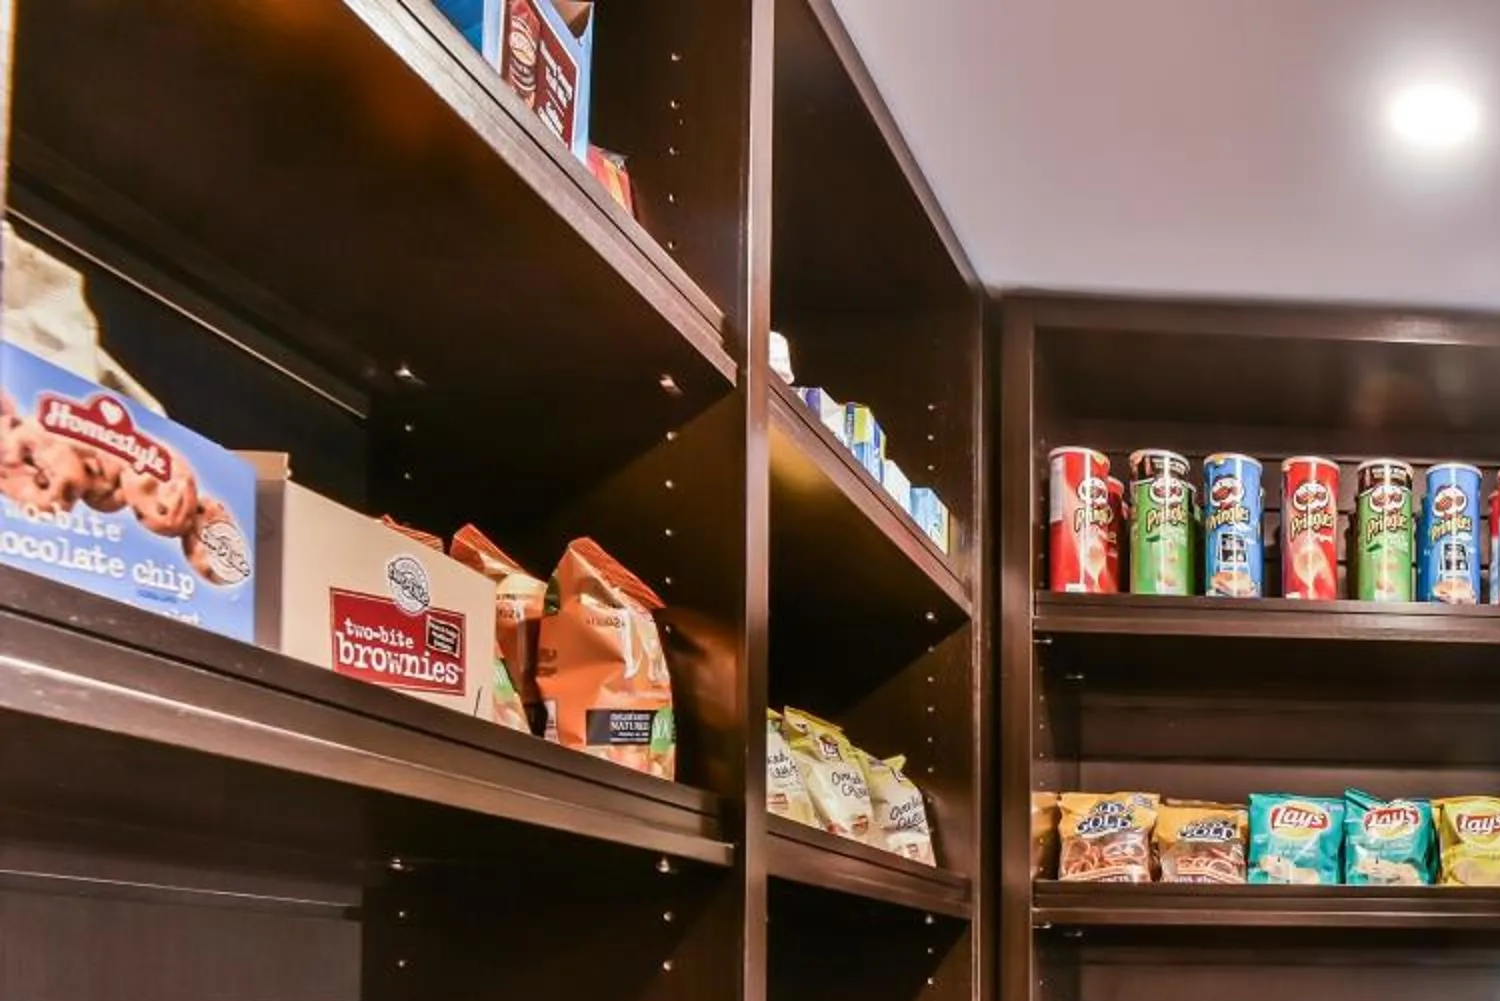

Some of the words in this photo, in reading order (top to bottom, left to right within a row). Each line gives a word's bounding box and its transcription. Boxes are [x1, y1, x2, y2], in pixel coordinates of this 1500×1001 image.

[44, 400, 168, 474] Homestyle
[0, 529, 125, 579] ocolate
[131, 559, 195, 600] chip
[336, 631, 460, 686] brownies
[343, 616, 416, 650] two-bite
